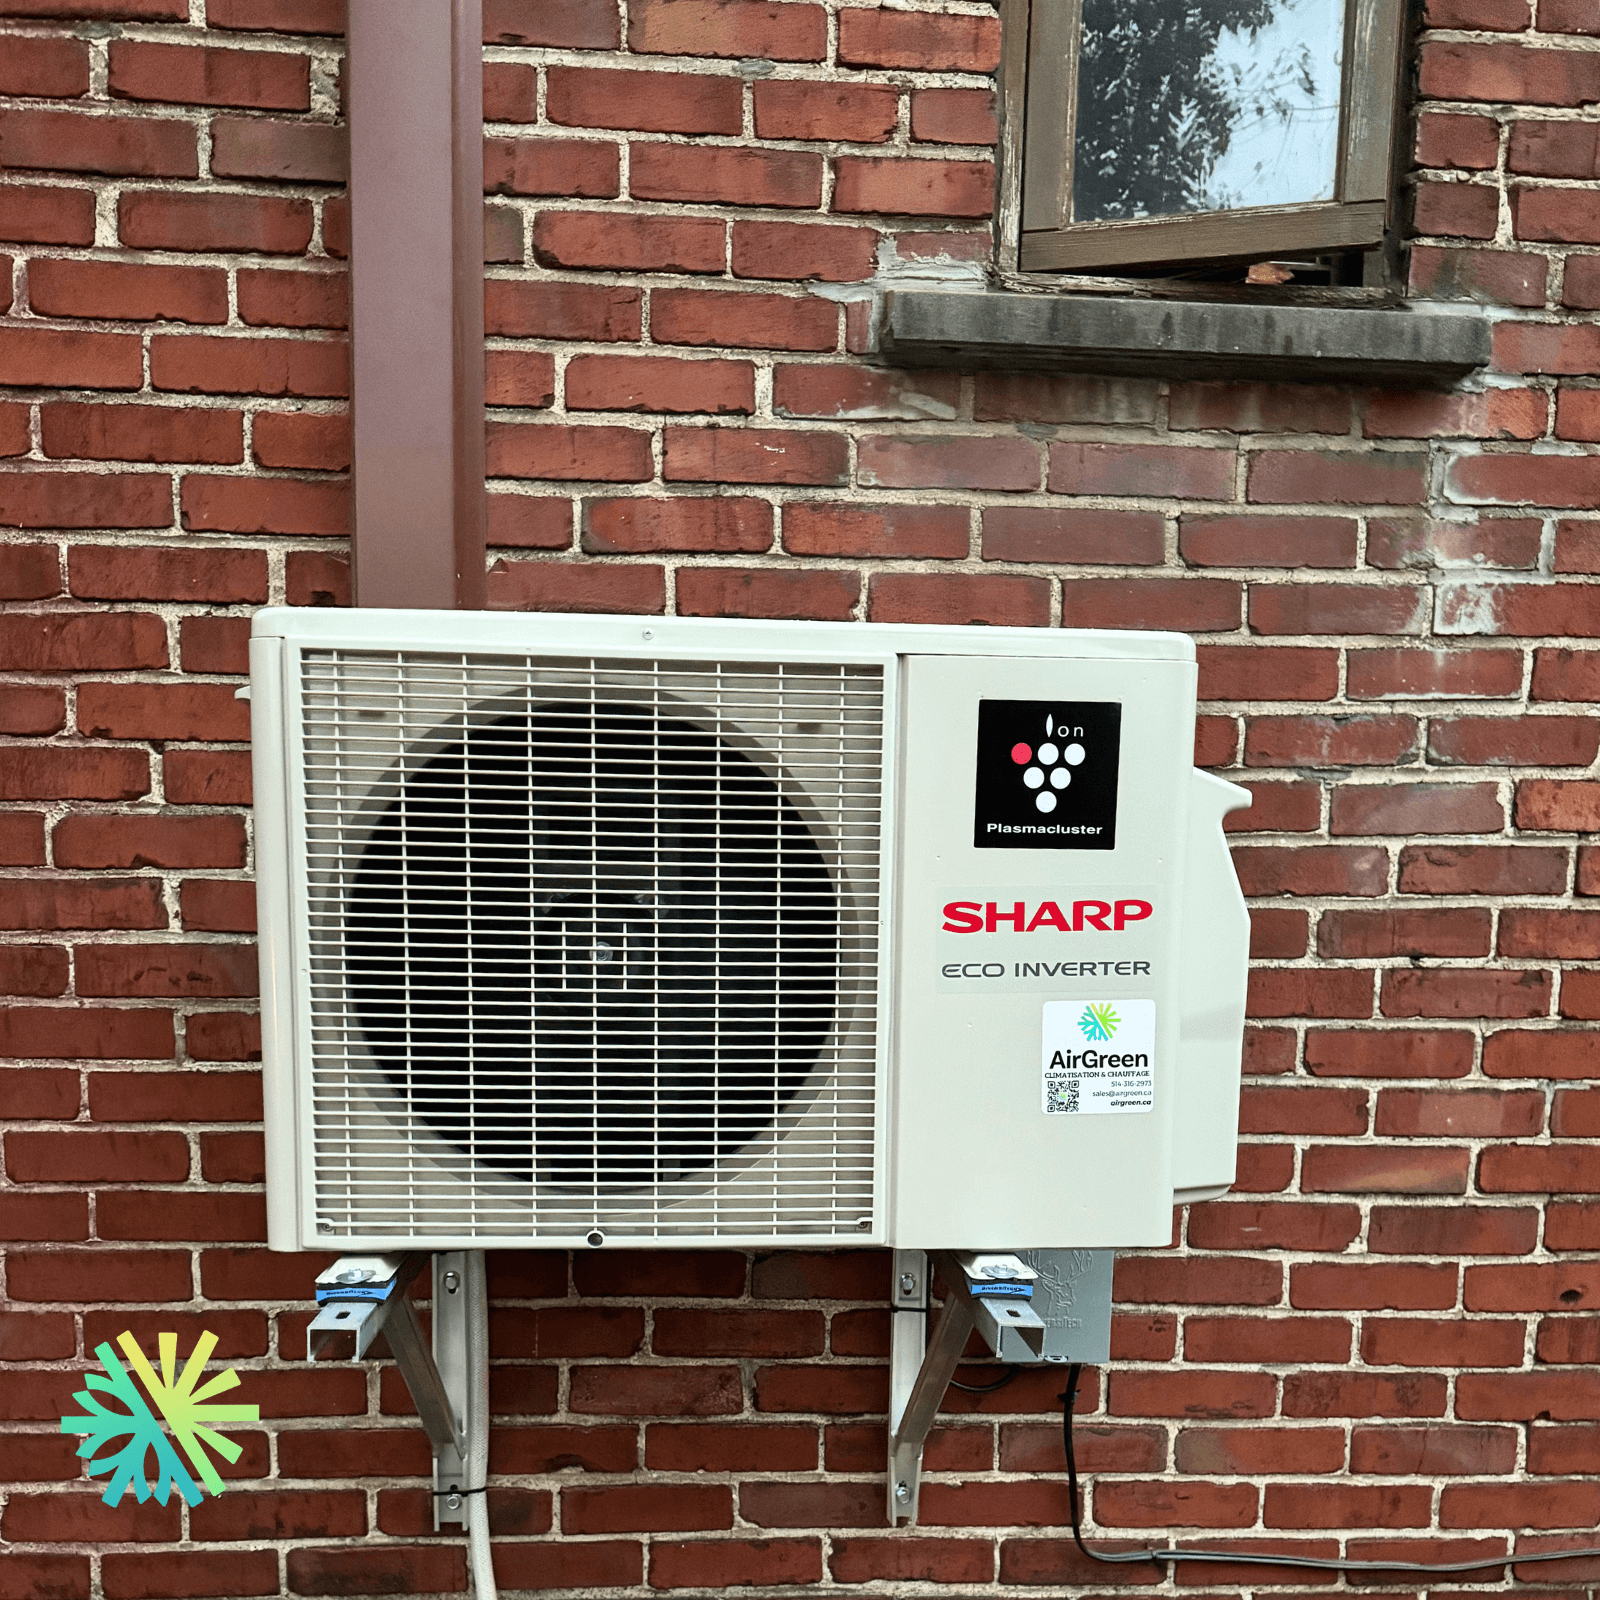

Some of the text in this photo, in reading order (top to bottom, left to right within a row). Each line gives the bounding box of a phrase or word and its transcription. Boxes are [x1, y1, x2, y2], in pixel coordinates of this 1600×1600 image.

[1046, 713, 1084, 738] Ion
[986, 823, 1103, 835] Plasmacluster
[941, 899, 1153, 934] SHARP
[941, 961, 1151, 979] ECO INVERTER
[1049, 1049, 1148, 1069] AirGreen
[1044, 1071, 1100, 1079] CLIMATISATION
[1107, 1070, 1150, 1078] CHAUFFAGE
